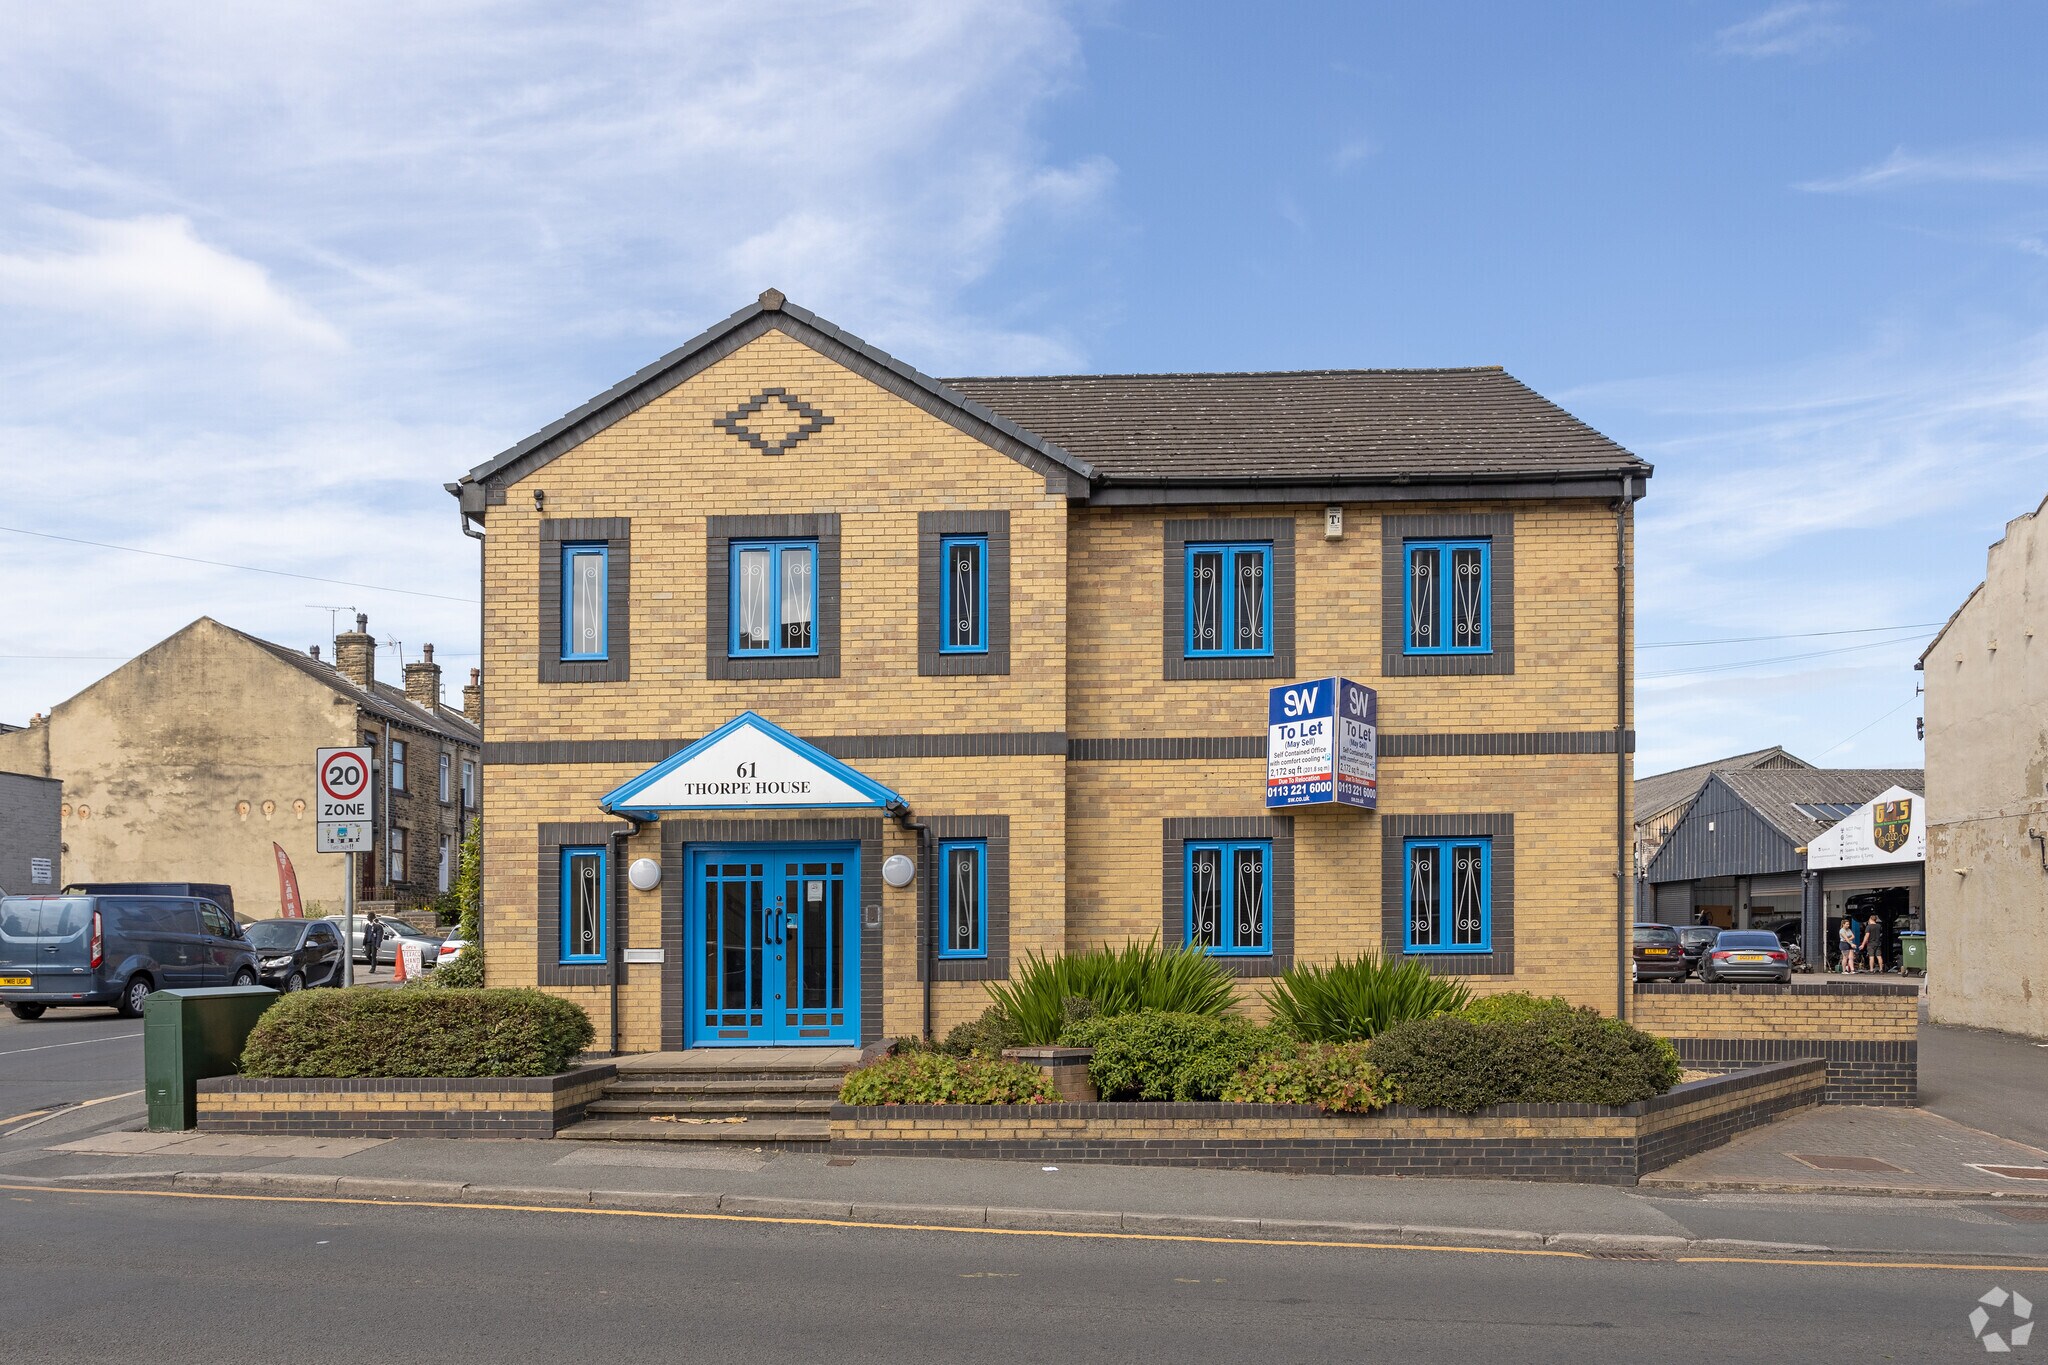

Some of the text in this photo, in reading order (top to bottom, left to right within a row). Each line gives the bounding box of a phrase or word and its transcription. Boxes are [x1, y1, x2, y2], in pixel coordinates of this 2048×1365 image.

[1284, 687, 1318, 717] SW
[1350, 687, 1369, 718] SW
[1278, 721, 1323, 740] To Let
[1346, 720, 1371, 742] To Let
[1285, 737, 1316, 750] (May Sell)
[1273, 746, 1327, 759] Self Contained Office
[1281, 757, 1301, 766] comfort
[1301, 754, 1321, 763] cooling
[736, 761, 757, 778] 61
[1270, 767, 1287, 778] 2,172
[1297, 765, 1302, 774] ft
[1340, 762, 1351, 773] 2,172
[329, 765, 360, 786] 20
[1295, 775, 1321, 783] Relocation
[685, 781, 811, 795] THORPE HOUSE
[1267, 781, 1332, 798] 0113 221 6000
[1338, 782, 1376, 799] 0113 221 6000
[1287, 795, 1310, 803] sw.co.uk
[325, 803, 365, 816] ZONE
